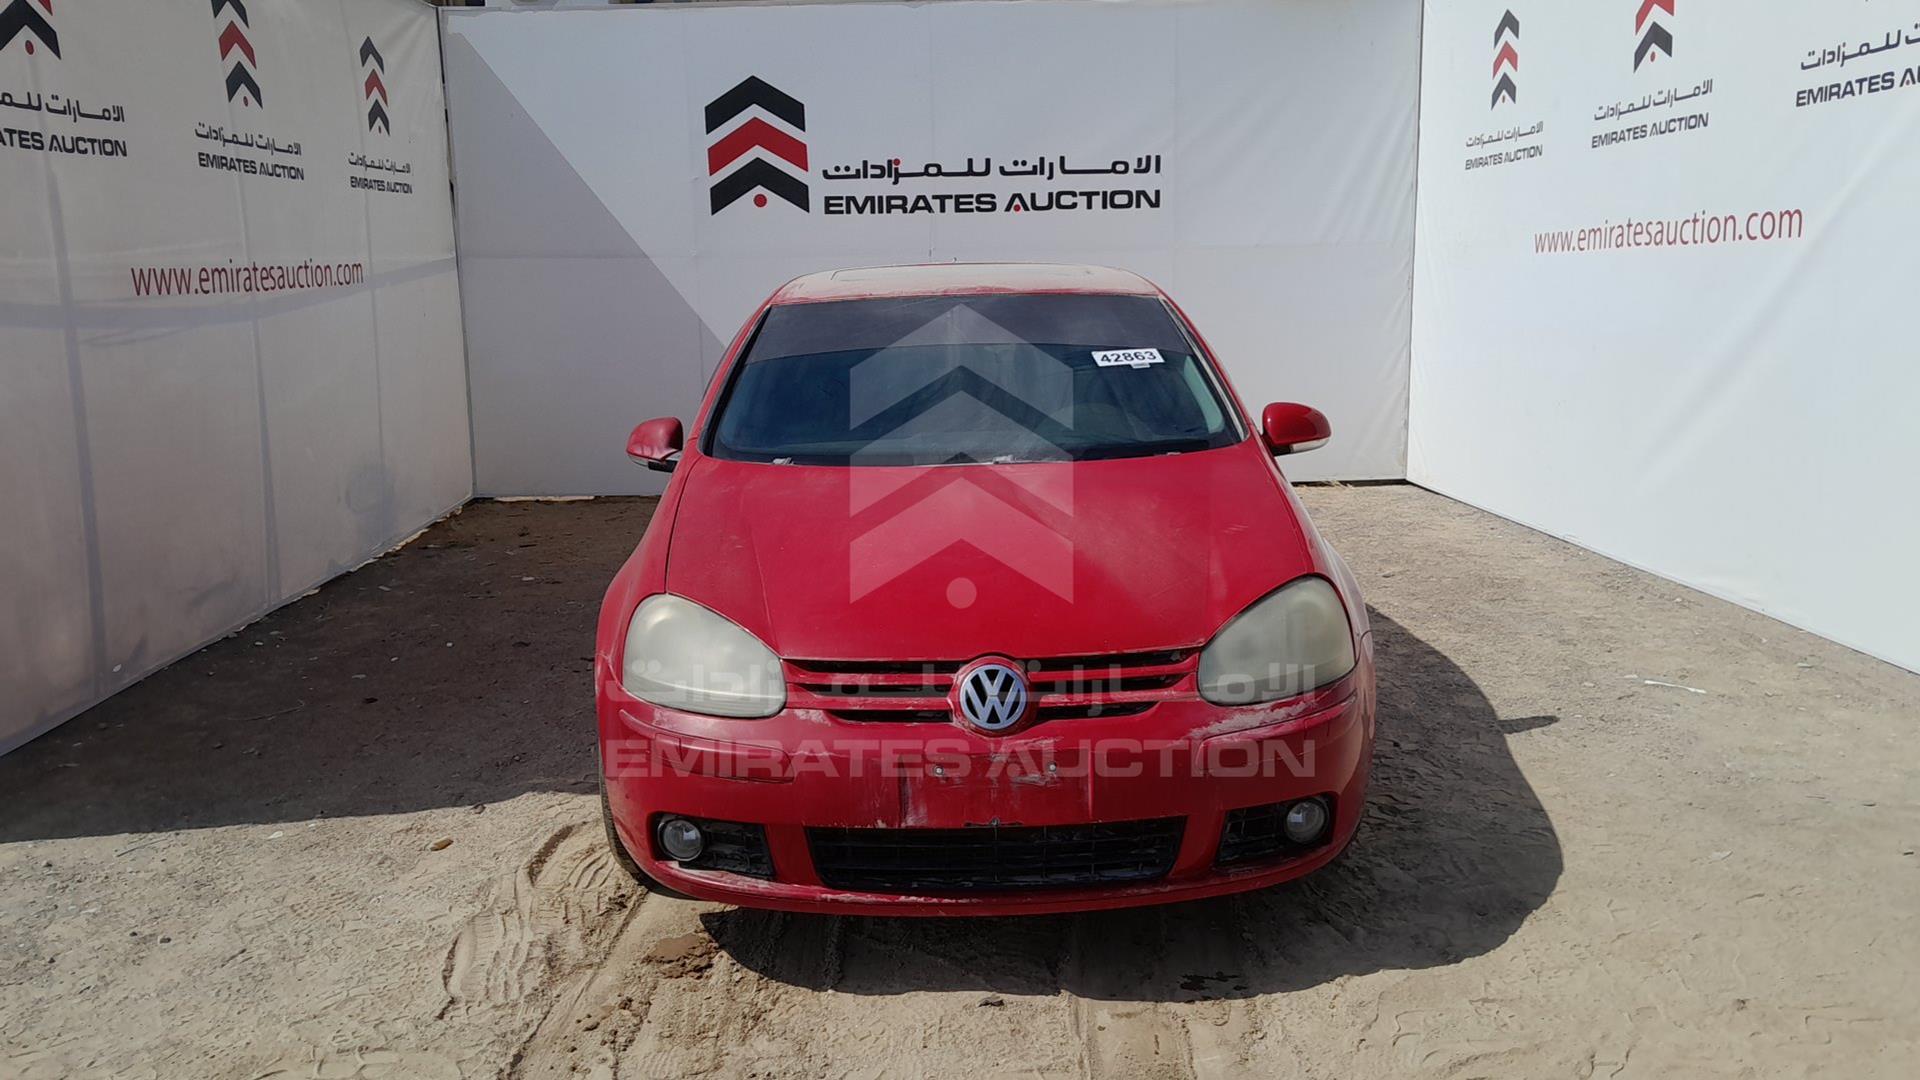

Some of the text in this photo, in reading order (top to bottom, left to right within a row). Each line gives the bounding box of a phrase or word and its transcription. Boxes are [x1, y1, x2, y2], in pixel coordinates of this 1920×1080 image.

[1796, 71, 1895, 107] EMIRATES
[1591, 112, 1709, 149] EMIRATES AUCTION
[48, 134, 127, 157] AUCTION
[1465, 144, 1543, 171] EMIRATES AUCTION
[198, 152, 305, 181] EMIRATES AUCTION
[823, 189, 1161, 215] EMIRATES AUCTION
[1534, 208, 1803, 254] www.emiratesauction.com
[131, 258, 365, 297] www.emiratesauction.com
[1100, 350, 1158, 364] 42863
